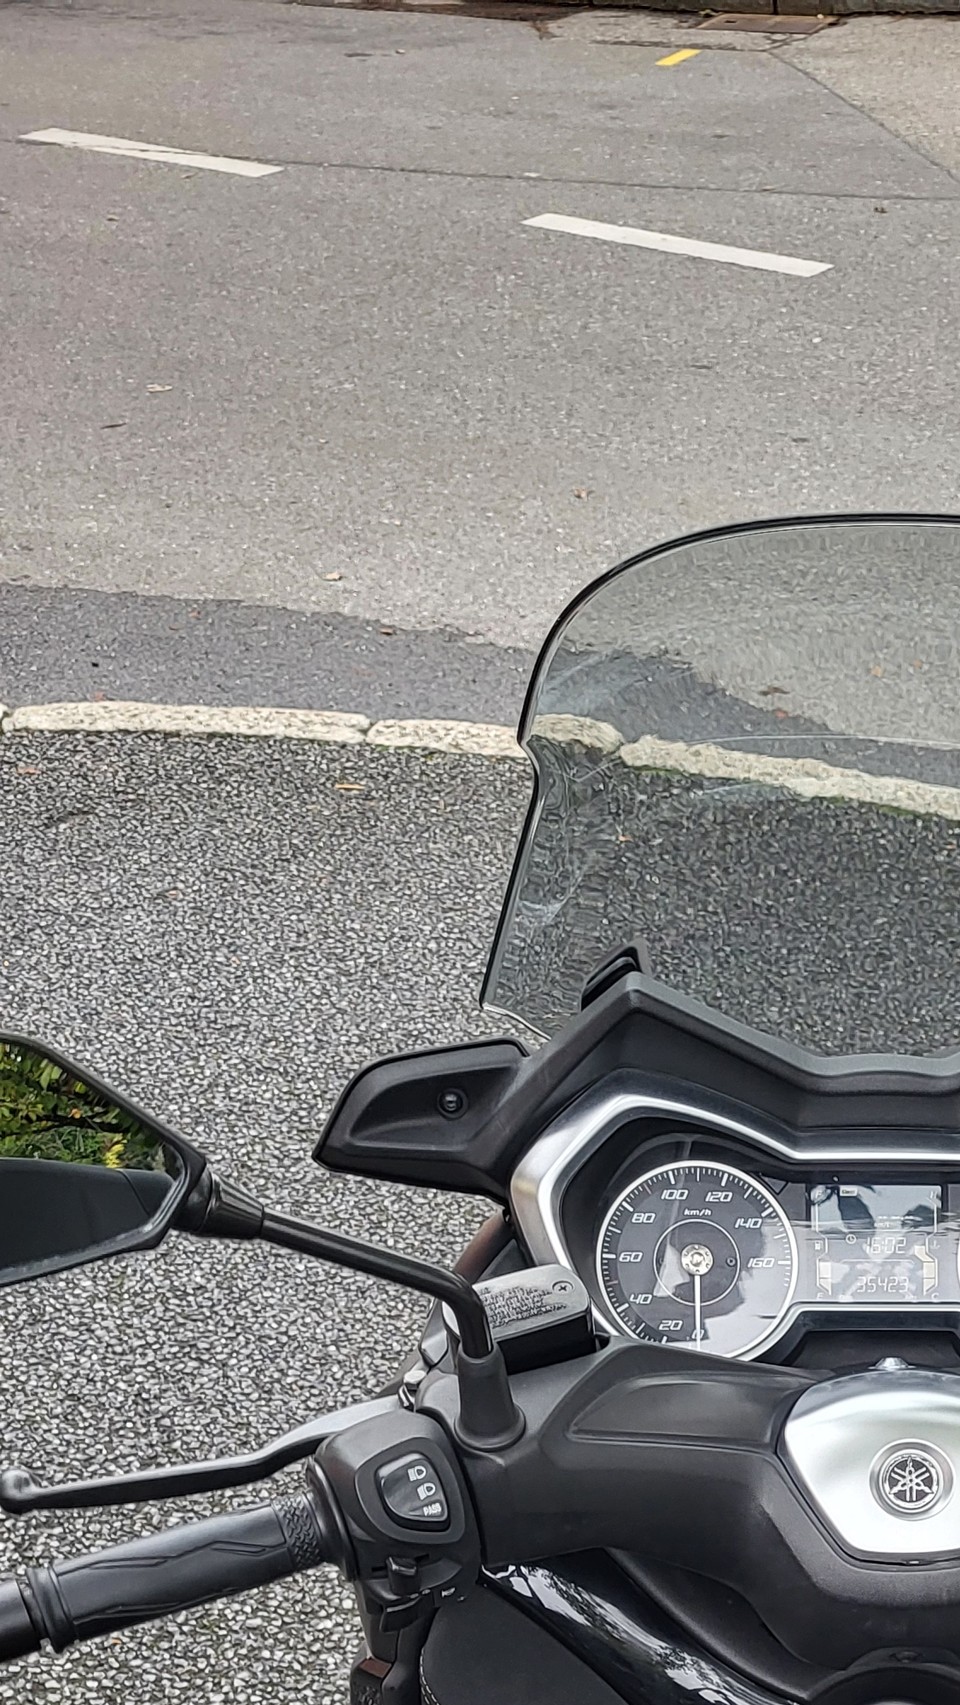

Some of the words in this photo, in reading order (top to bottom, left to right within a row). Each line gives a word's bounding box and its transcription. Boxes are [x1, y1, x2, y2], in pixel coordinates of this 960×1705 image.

[661, 1189, 689, 1200] 100
[705, 1191, 733, 1202] 120
[631, 1212, 656, 1224] 80
[684, 1208, 712, 1217] km/h
[735, 1218, 763, 1229] 140
[866, 1237, 906, 1254] 16:02
[618, 1252, 643, 1263] 60
[747, 1257, 775, 1268] 160
[857, 1276, 909, 1292] 35423
[629, 1294, 652, 1304] 40
[658, 1320, 683, 1330] 20
[691, 1329, 705, 1339] 0
[423, 1502, 442, 1517] PASS
